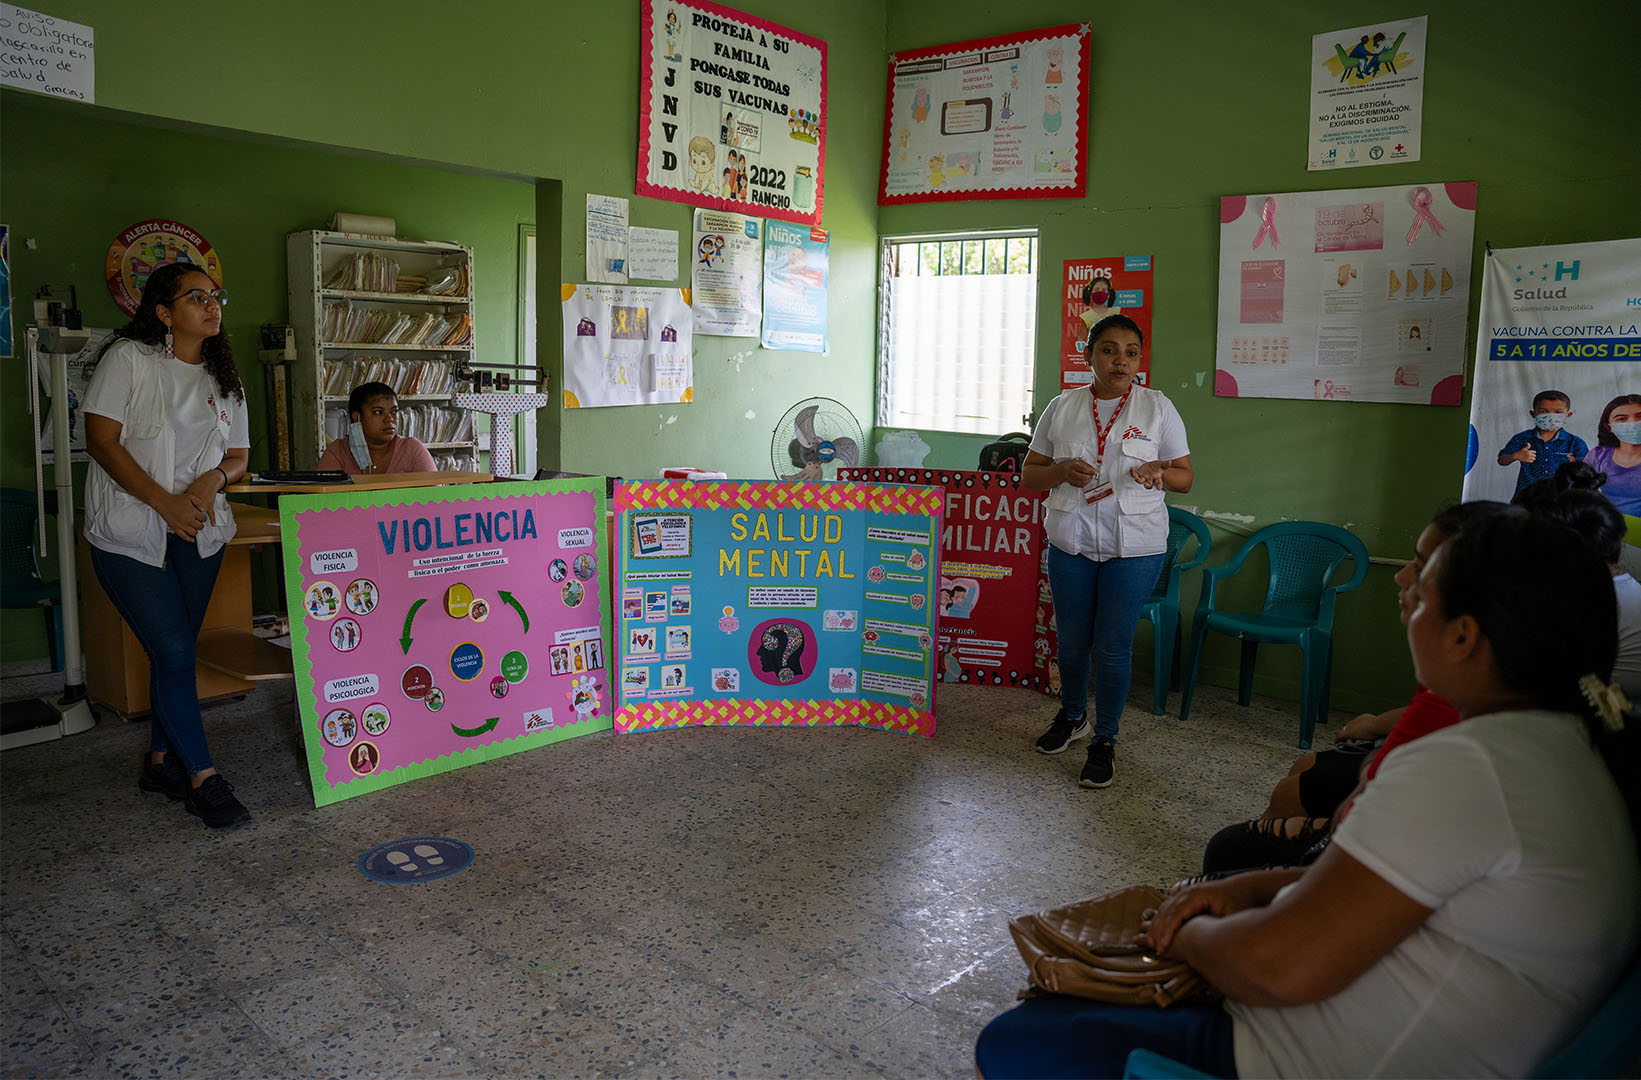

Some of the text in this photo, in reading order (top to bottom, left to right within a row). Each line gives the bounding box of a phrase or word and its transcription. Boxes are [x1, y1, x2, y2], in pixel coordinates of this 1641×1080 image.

[692, 13, 789, 54] PROTEJA A SU
[714, 42, 770, 71] FAMILIA
[56, 60, 72, 72] de
[690, 58, 790, 97] PONGASE TODAS
[694, 80, 788, 116] SUS VACUNAS
[1329, 114, 1400, 128] EXIGIMOS EQUIDAD
[1337, 112, 1347, 120] LA
[750, 165, 786, 190] 2022
[752, 189, 790, 209] RANCHO
[125, 222, 202, 246] ALERTA CÁNCER
[769, 226, 802, 245] Niños
[1068, 265, 1112, 281] Niños
[1554, 260, 1581, 281] H
[1513, 287, 1567, 300] Salud
[1492, 325, 1638, 337] VACUNA CONTRA LA
[1496, 340, 1641, 357] 5 A 11 AÑOS DE
[377, 509, 537, 555] VIOLENCIA
[560, 530, 589, 538] VIOLENCIA
[729, 511, 842, 544] SALUD
[315, 551, 353, 561] VIOLENCIA
[432, 554, 464, 564] intencional
[718, 548, 855, 579] MENTAL
[323, 563, 346, 571] FISICA
[444, 565, 461, 574] poder
[456, 660, 477, 668] VIOLENCIA
[332, 677, 370, 689] VIOLENCIA
[329, 686, 376, 701] PSICOLOGICA
